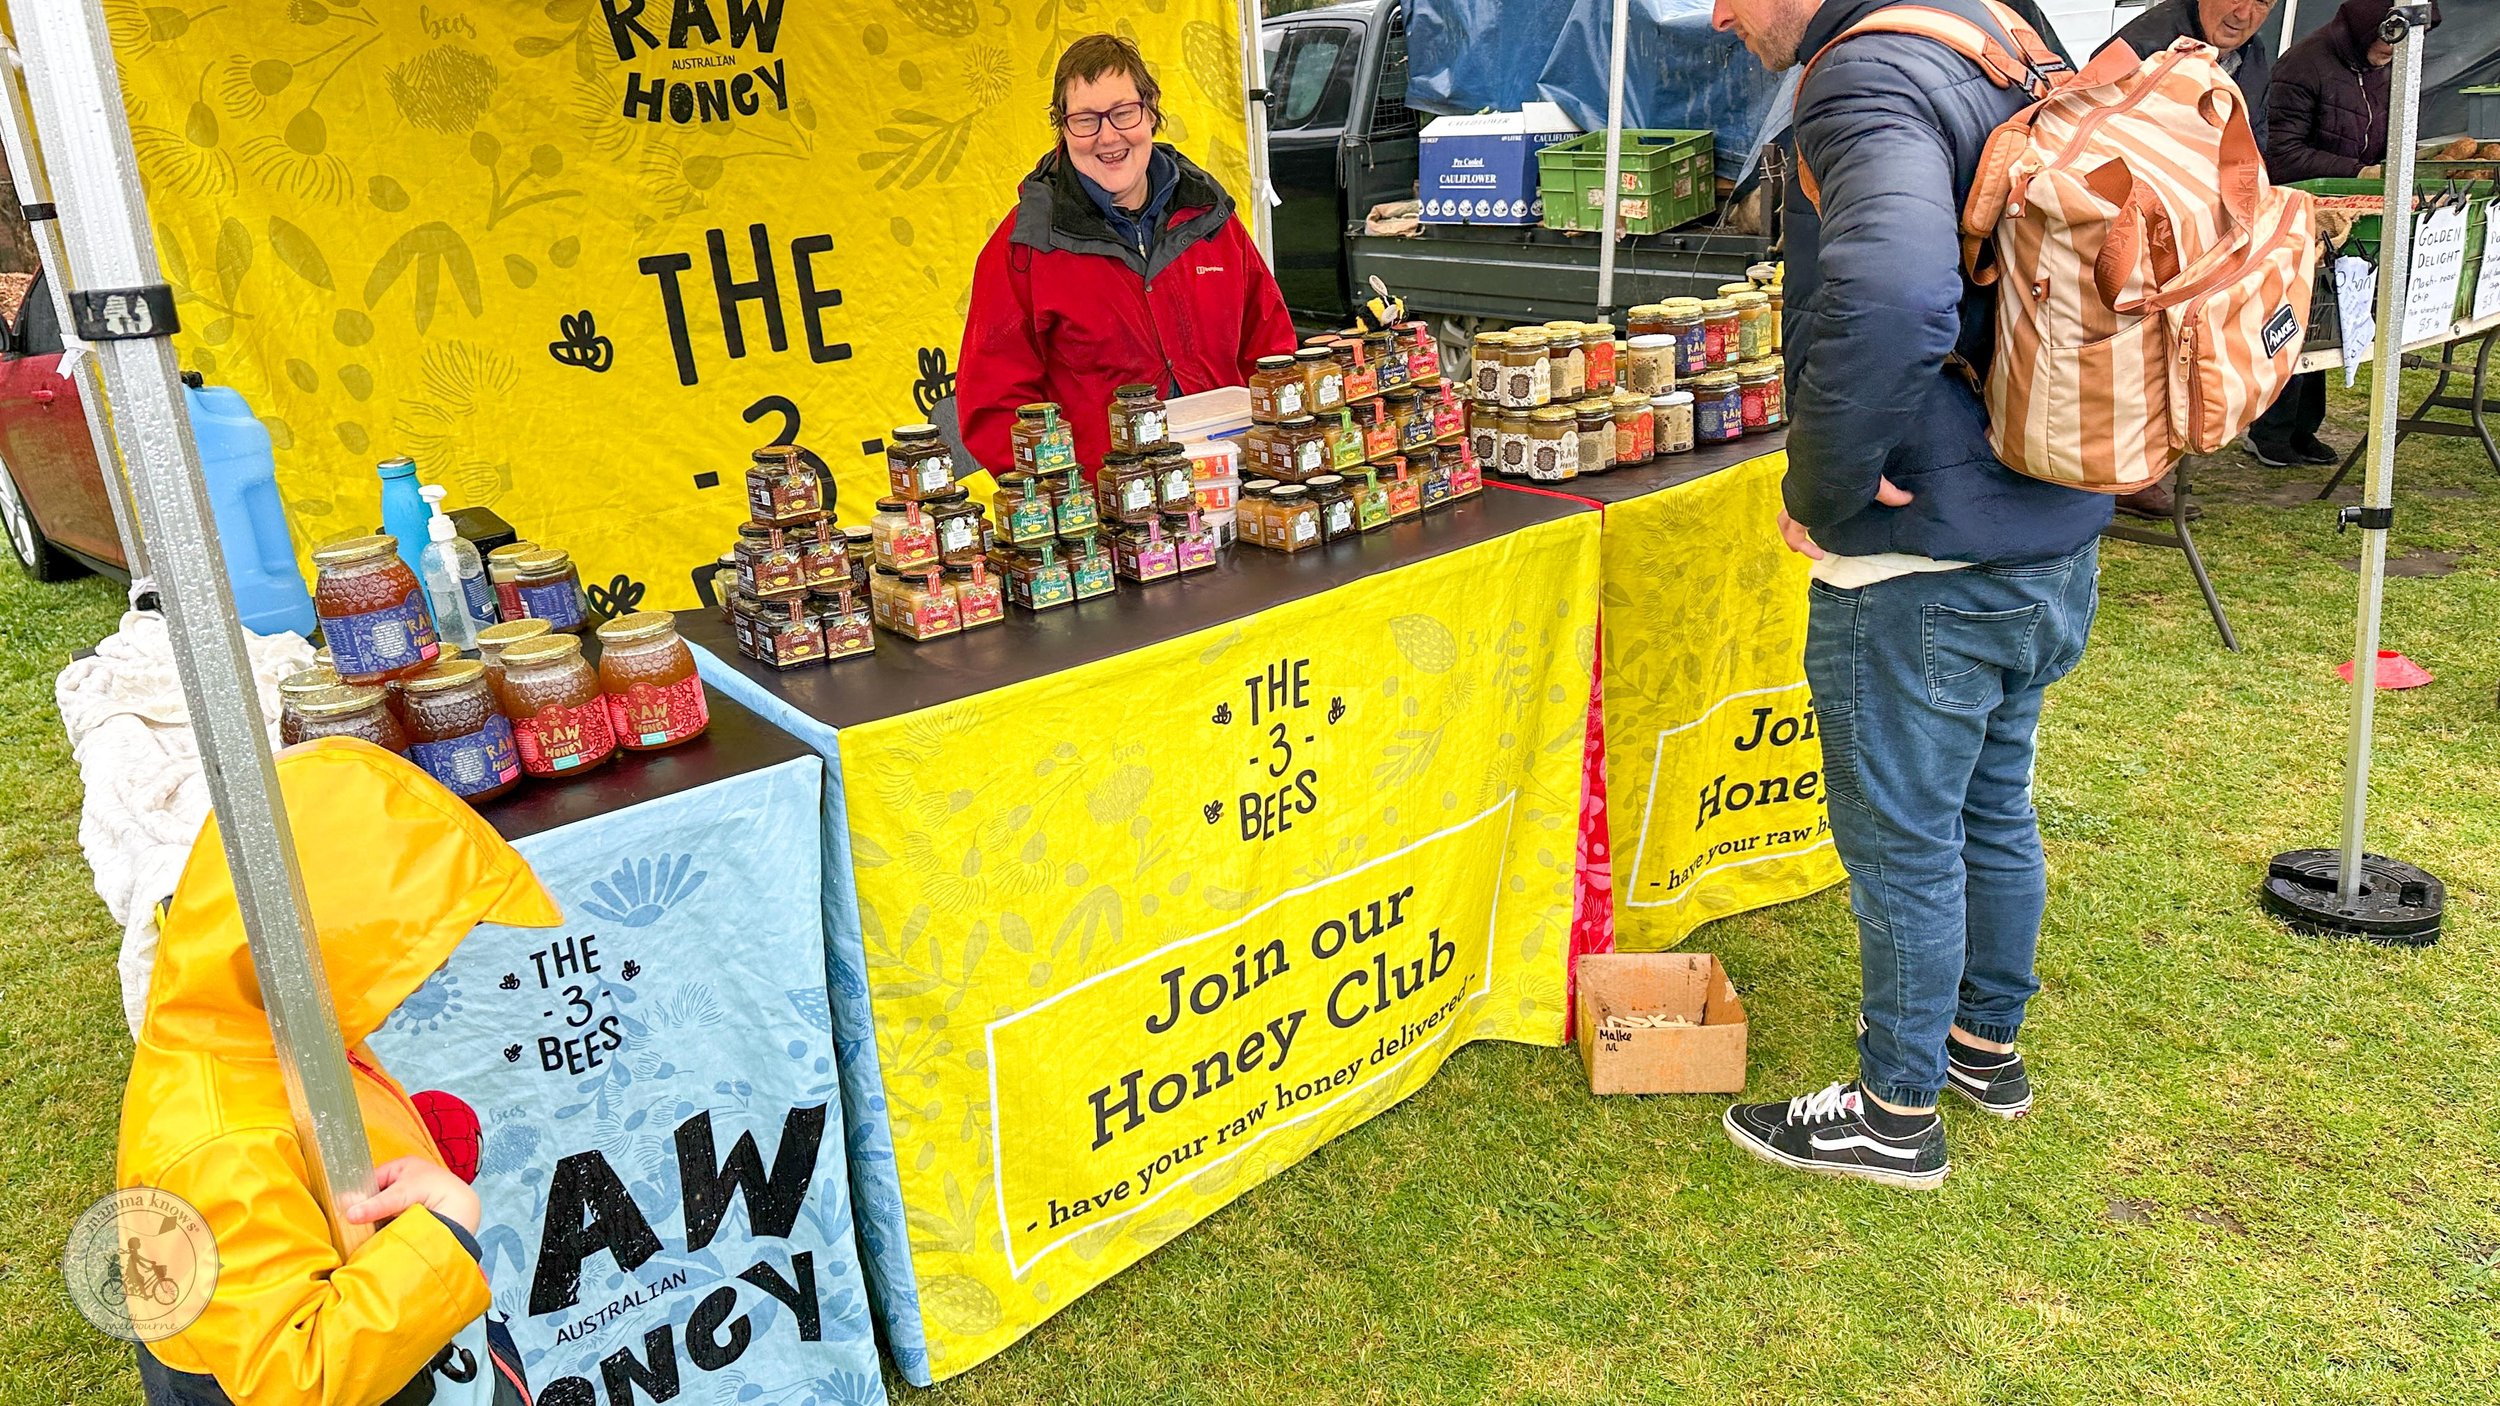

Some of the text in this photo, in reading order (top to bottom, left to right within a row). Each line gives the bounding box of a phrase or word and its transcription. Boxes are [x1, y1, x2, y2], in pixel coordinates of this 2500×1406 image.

[600, 0, 784, 61] RAW
[672, 55, 736, 70] AUSTRALIAN
[1440, 174, 1496, 184] CAULIFLOWER
[1464, 158, 1483, 166] Cooled
[2418, 226, 2462, 247] GOLDEN
[2418, 249, 2460, 269] DELIGHT
[638, 223, 853, 387] THE
[2269, 318, 2295, 347] NAKIE
[629, 703, 668, 722] RAW
[1245, 658, 1310, 726] THE
[538, 724, 580, 746] RAW
[1735, 697, 1823, 752] Joi
[1239, 769, 1317, 842] BEES
[1667, 855, 1703, 891] have
[1706, 835, 1760, 865] your
[1766, 827, 1812, 847] raw
[529, 934, 602, 989] THE
[1145, 885, 1414, 1034] Join our
[537, 1015, 622, 1076] BEES
[1088, 927, 1456, 1152] Honey Club
[1048, 1180, 1130, 1228] have
[1136, 1134, 1210, 1195] your
[1216, 1100, 1268, 1146] raw
[1275, 1057, 1363, 1111] honey
[1370, 975, 1468, 1066] delivered
[557, 1268, 687, 1346] AUSTRALIAN
